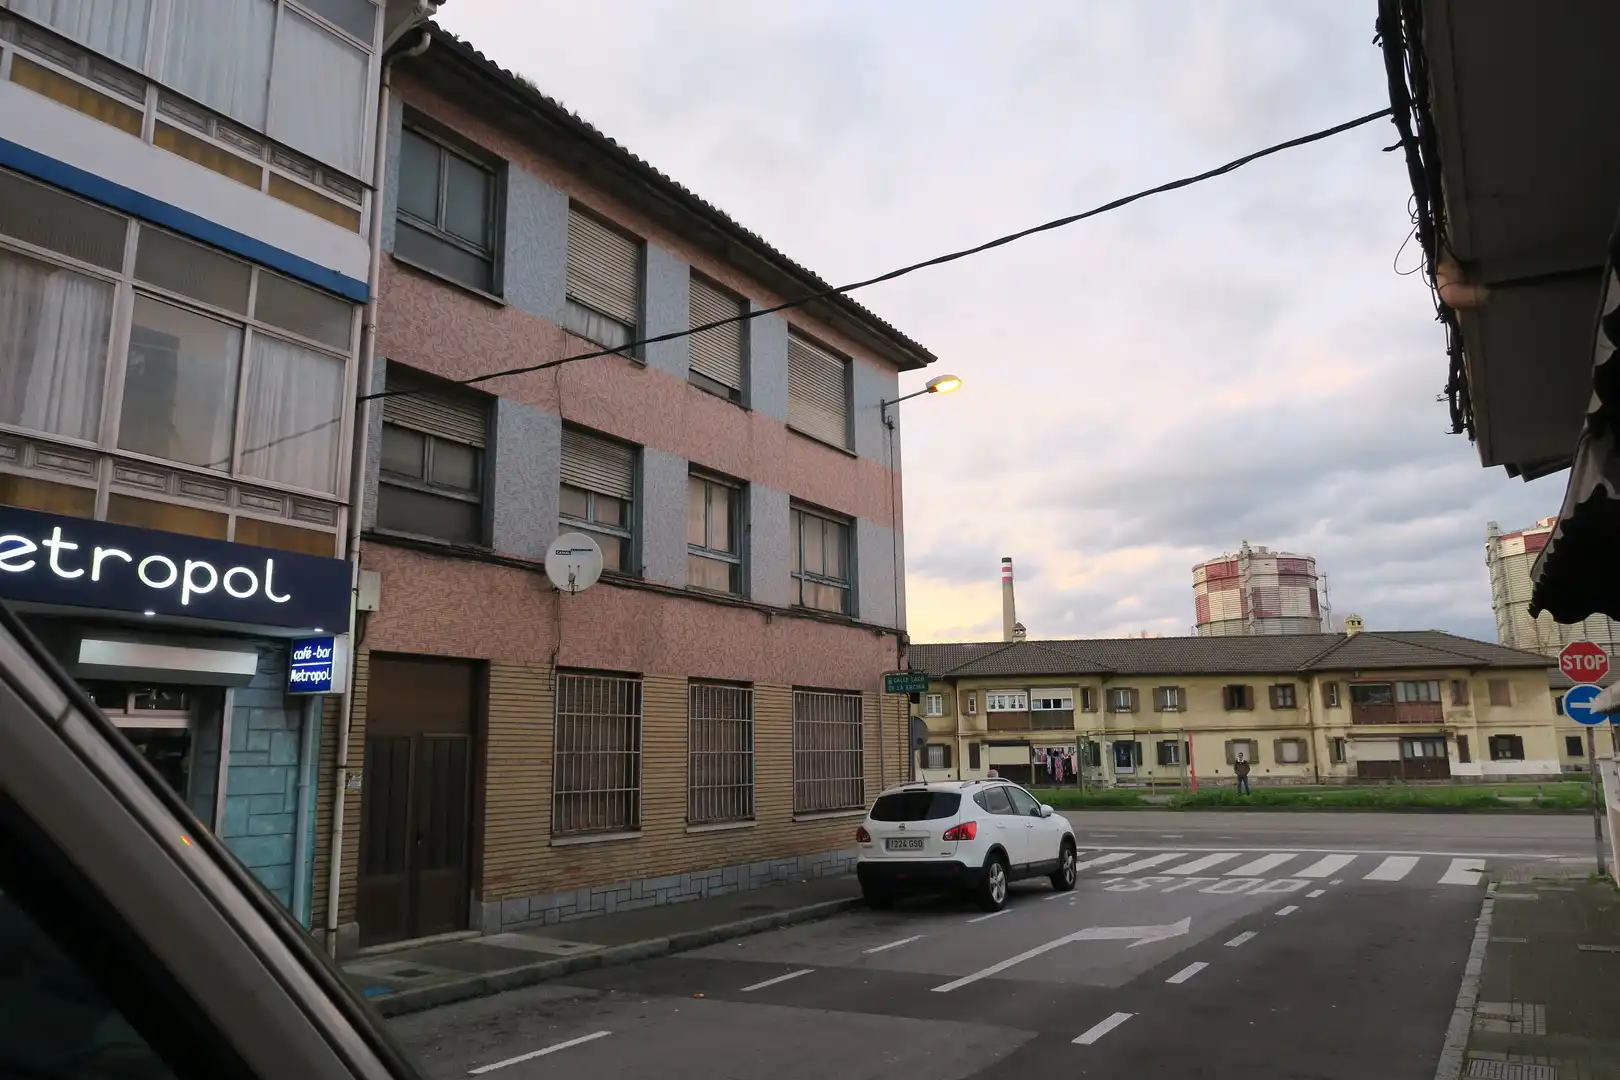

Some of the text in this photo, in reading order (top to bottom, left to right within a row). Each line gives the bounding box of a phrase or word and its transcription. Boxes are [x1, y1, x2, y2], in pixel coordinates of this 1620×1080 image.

[0, 527, 291, 605] etropol
[1562, 654, 1606, 670] STOP
[290, 667, 331, 684] Metropol
[891, 840, 907, 848] 1224
[1100, 876, 1314, 895] STOP
